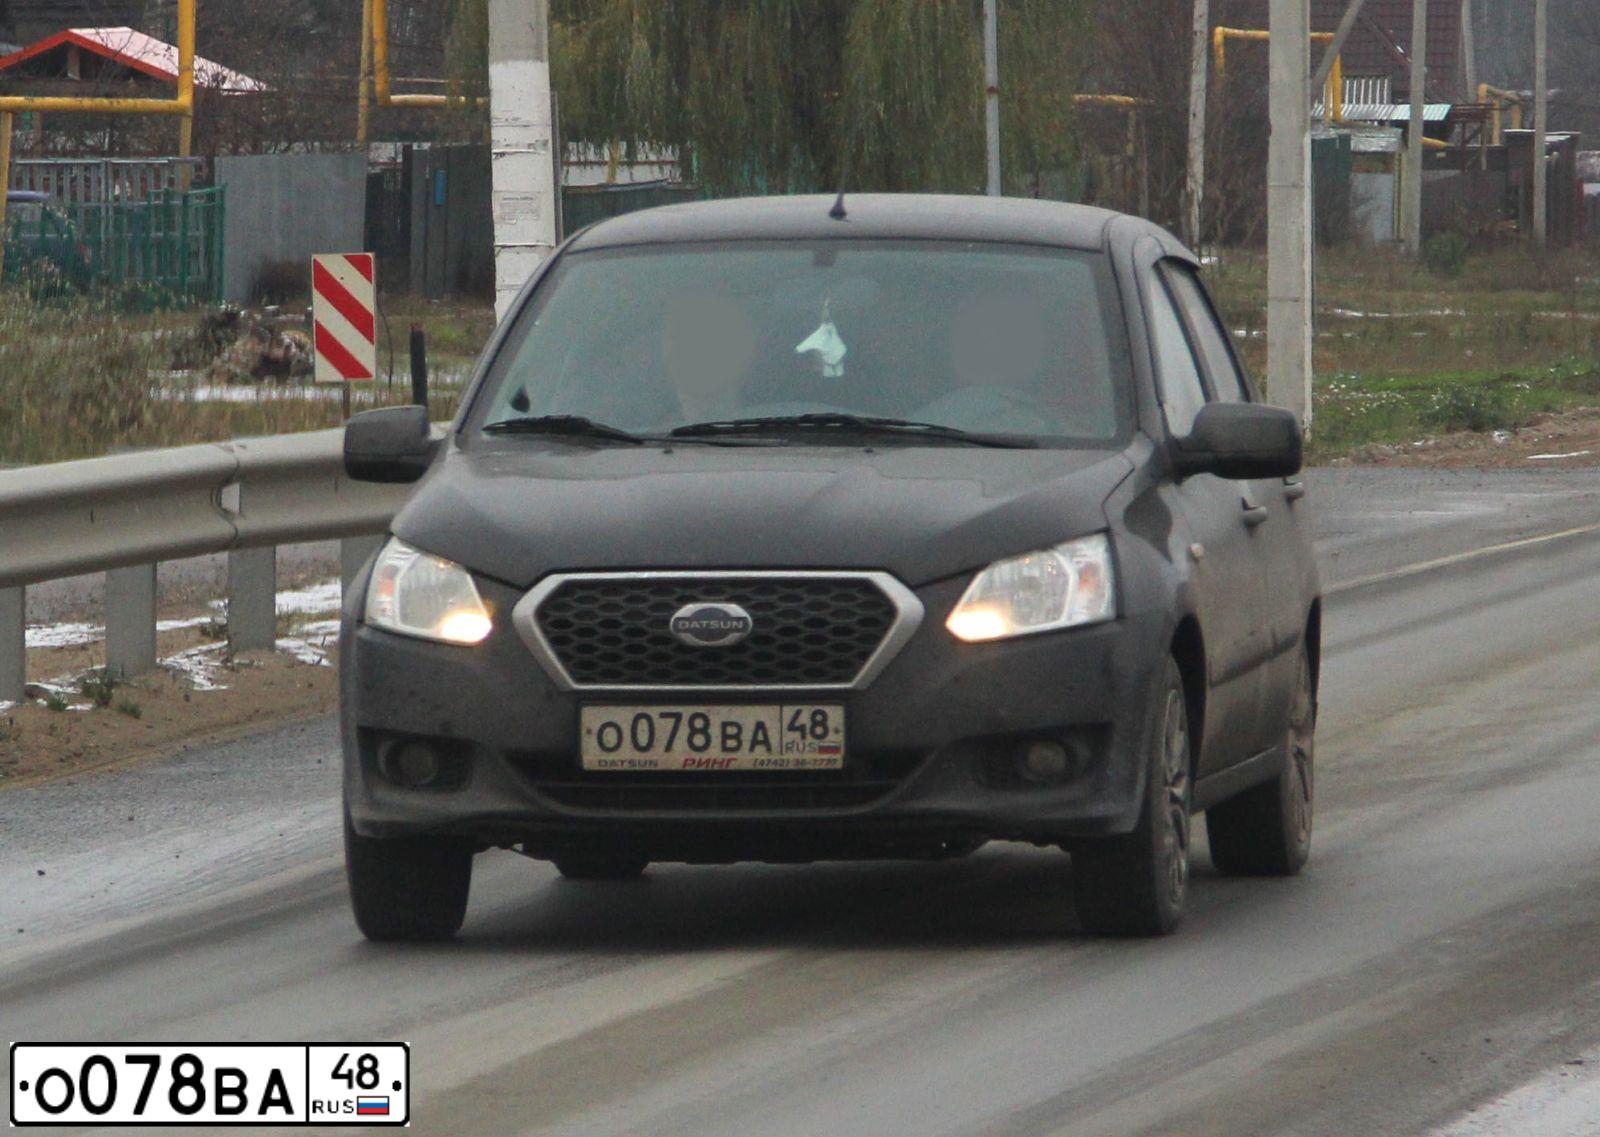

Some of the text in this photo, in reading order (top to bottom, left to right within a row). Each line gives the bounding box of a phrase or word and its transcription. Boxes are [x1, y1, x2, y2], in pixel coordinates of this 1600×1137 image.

[678, 620, 743, 629] DATSUN
[786, 708, 829, 741] 48
[784, 741, 818, 754] RUS
